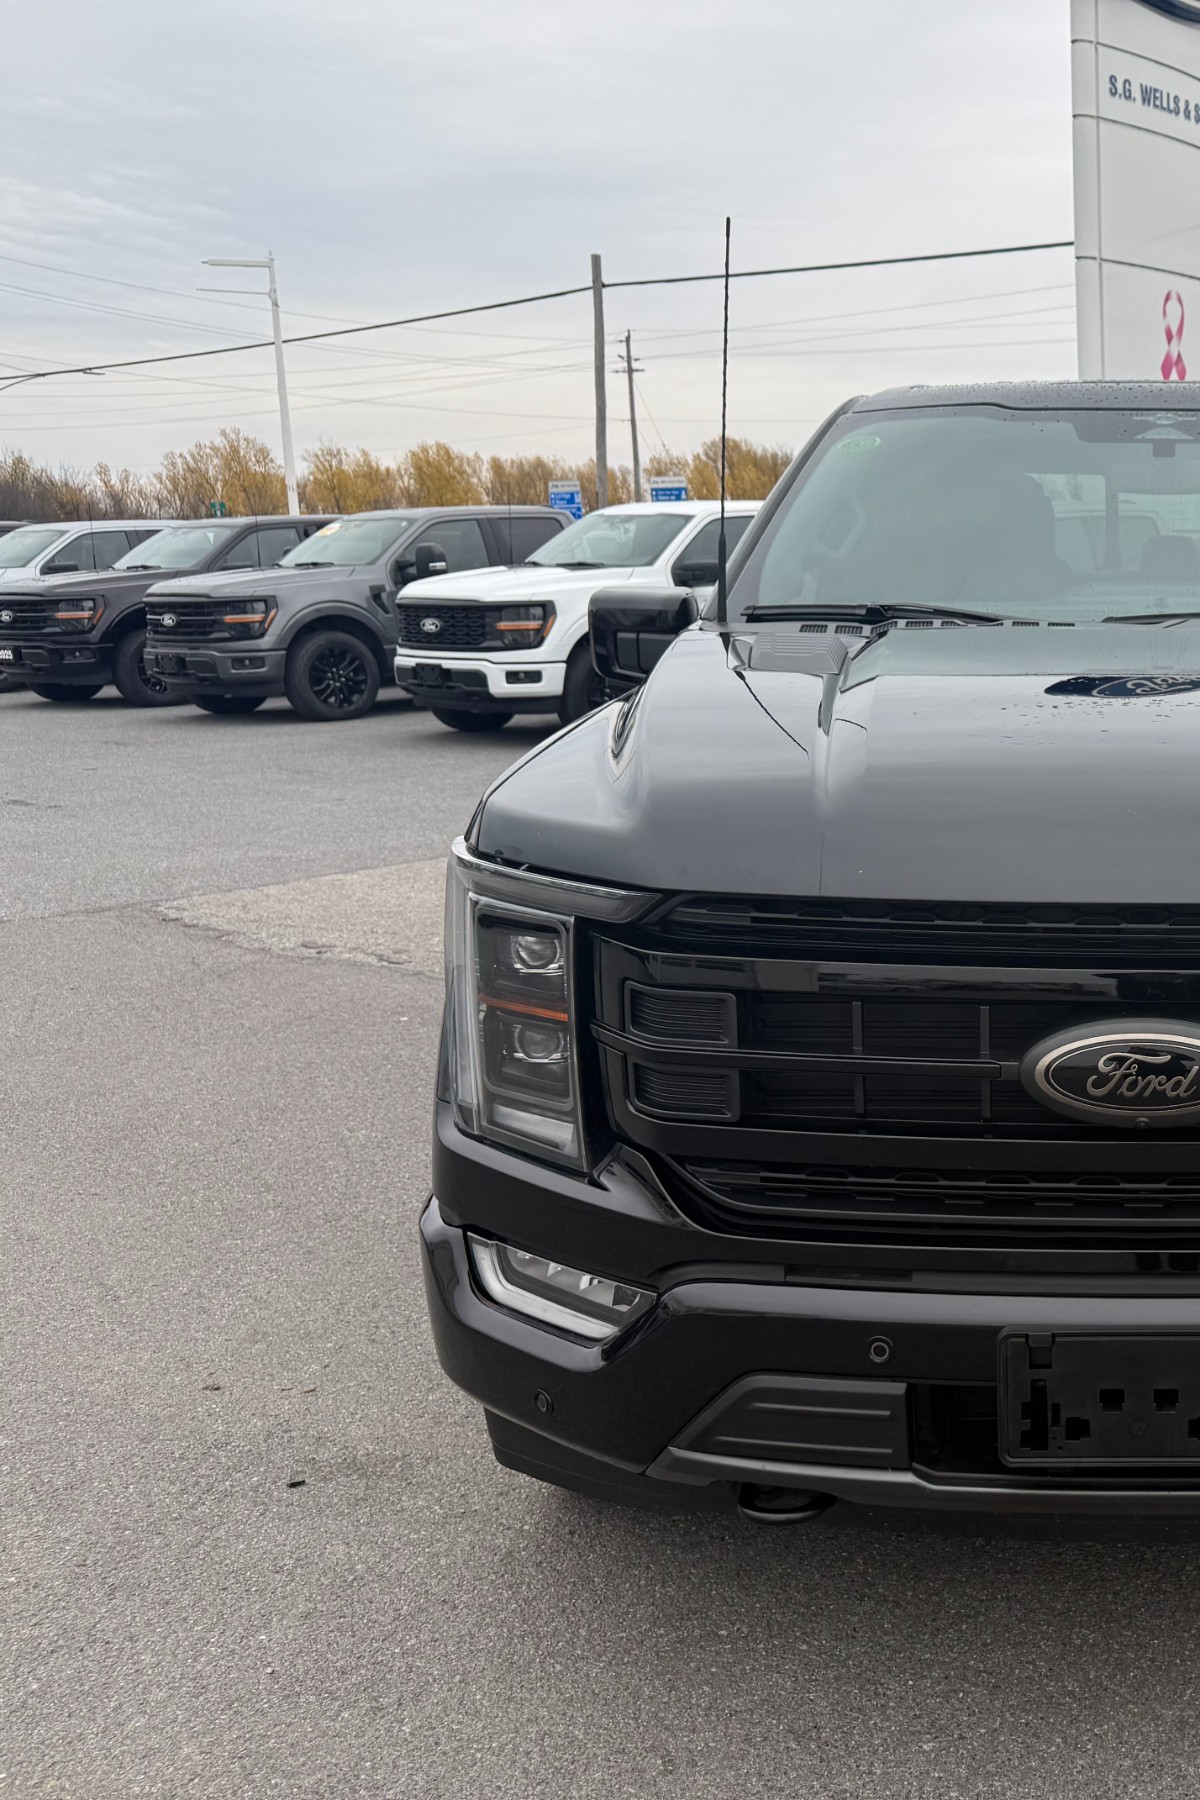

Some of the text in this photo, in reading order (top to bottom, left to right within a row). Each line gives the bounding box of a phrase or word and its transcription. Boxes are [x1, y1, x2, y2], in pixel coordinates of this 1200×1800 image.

[1108, 74, 1136, 102] S.G.
[1140, 82, 1180, 117] WELLS
[1183, 98, 1191, 121] &
[1086, 1052, 1199, 1097] Ford
